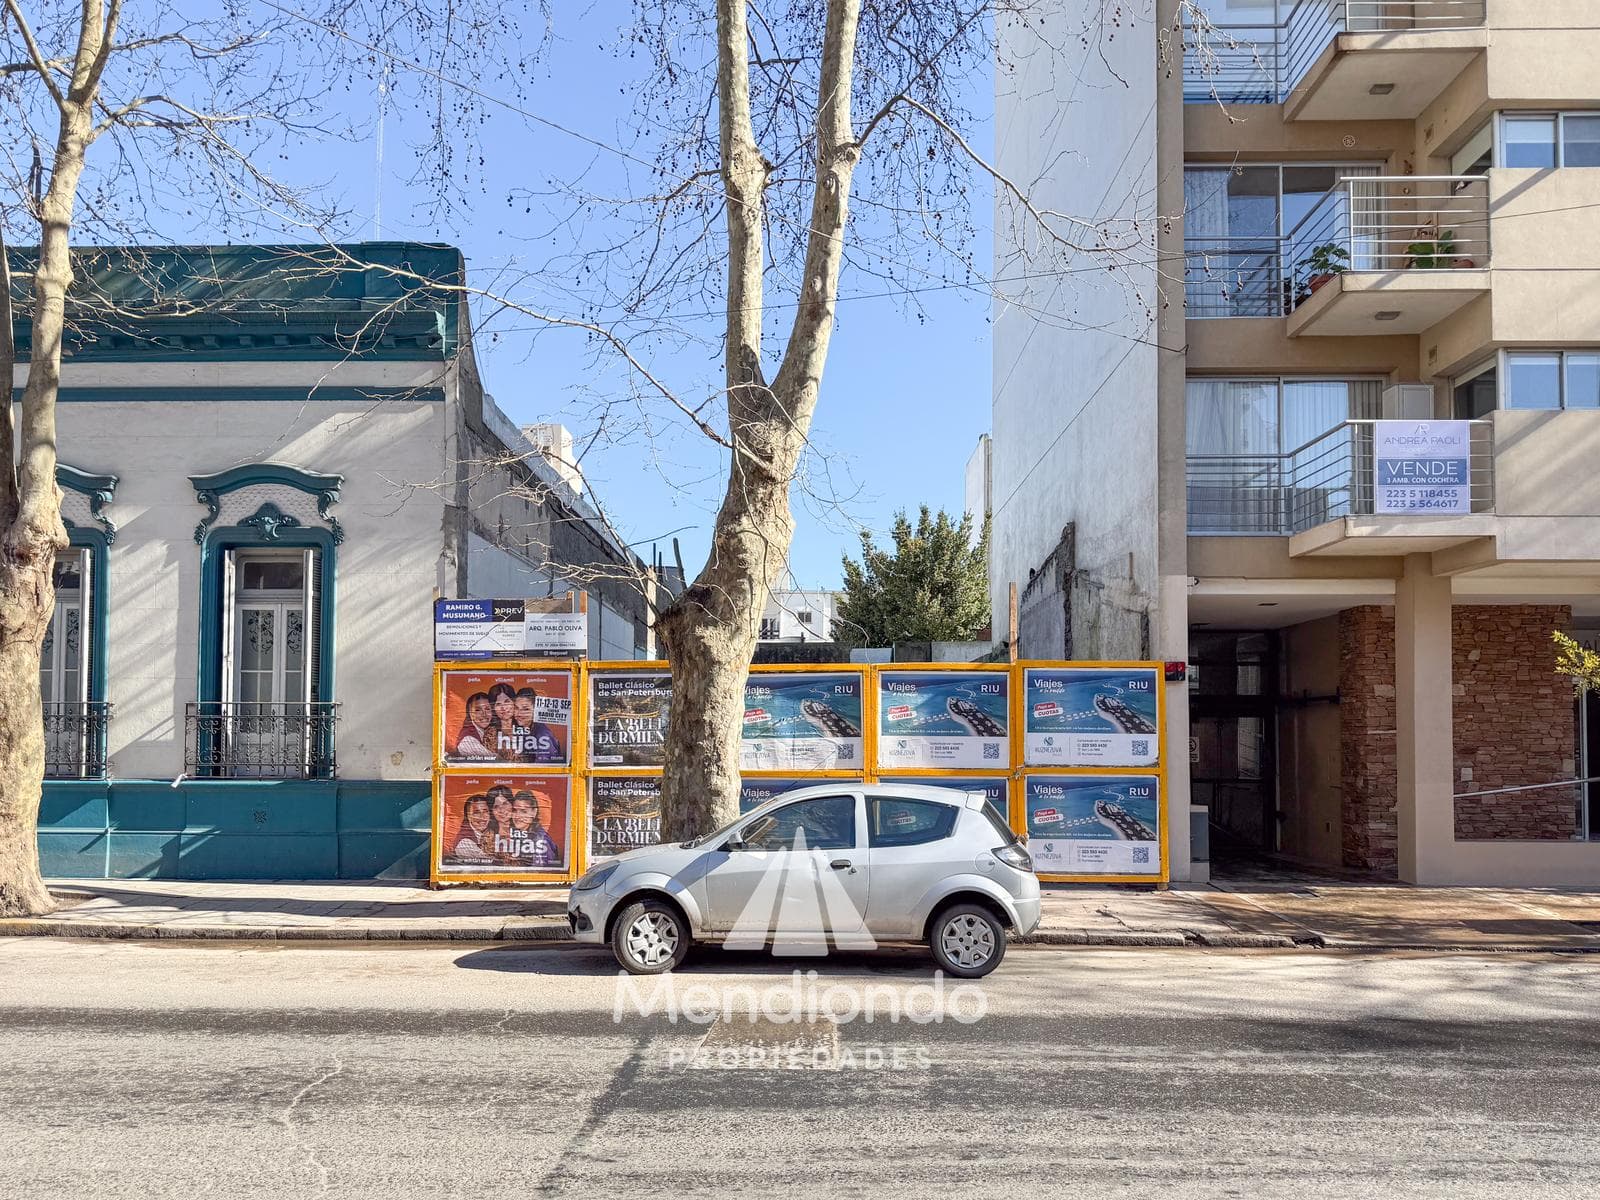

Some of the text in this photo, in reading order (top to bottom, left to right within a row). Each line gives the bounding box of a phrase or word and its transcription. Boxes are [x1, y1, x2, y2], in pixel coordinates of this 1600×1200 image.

[1386, 462, 1458, 475] VENDE
[834, 685, 853, 693] RIU
[888, 683, 916, 692] Viajes
[981, 685, 1000, 693] RIU
[1034, 679, 1063, 689] Viajes
[1128, 681, 1148, 689] RIU
[537, 699, 559, 708] 11-12-13
[512, 725, 530, 735] las
[605, 718, 663, 733] LA BELL
[598, 731, 664, 743] DURMIEN
[497, 731, 550, 754] hijas
[742, 788, 770, 798] Viajes
[984, 789, 999, 797] IU
[1033, 785, 1063, 795] Viajes
[1129, 787, 1149, 796] RIU
[604, 818, 660, 833] LA BELL
[510, 828, 528, 838] las
[597, 832, 661, 844] DURMIEN
[495, 834, 548, 857] hijas
